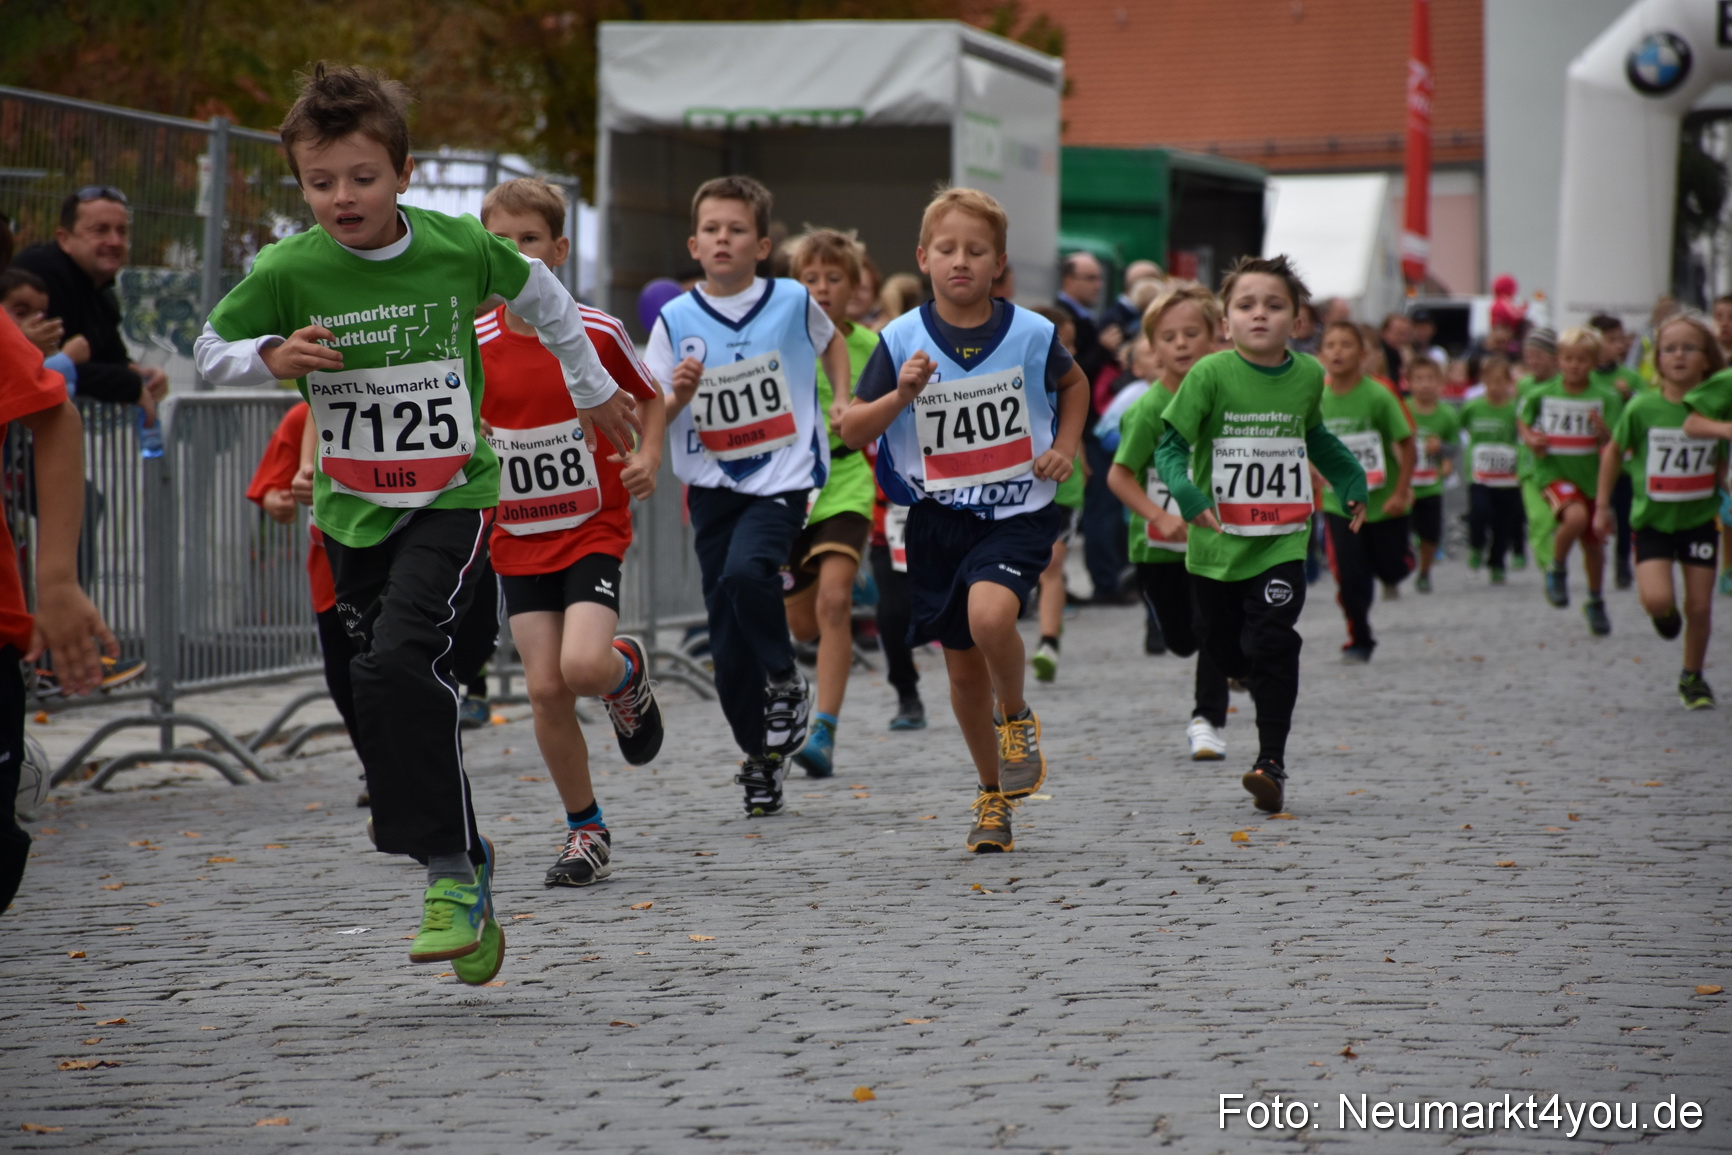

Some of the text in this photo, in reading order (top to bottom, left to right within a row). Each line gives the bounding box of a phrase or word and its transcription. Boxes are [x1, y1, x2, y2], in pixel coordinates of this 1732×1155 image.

[310, 304, 416, 328] Neumarkter
[718, 366, 766, 385] Neumarkt
[311, 377, 439, 396] PARTL Neumarkt
[916, 383, 1008, 407] PARTL Neumarkt
[698, 377, 781, 426] 7019
[329, 396, 459, 453] 7125
[926, 396, 1023, 449] 7402
[1224, 411, 1293, 423] Neumarkter
[727, 428, 766, 447] Jonas
[1222, 424, 1280, 437] Stadtlauf
[460, 443, 467, 452] K
[487, 433, 568, 451] ARTL Neumarkt
[1215, 448, 1249, 457] PARTL
[374, 467, 416, 488] Luis
[1223, 462, 1302, 499] 7041
[502, 500, 577, 521] Johannes
[1250, 508, 1280, 522] Paul
